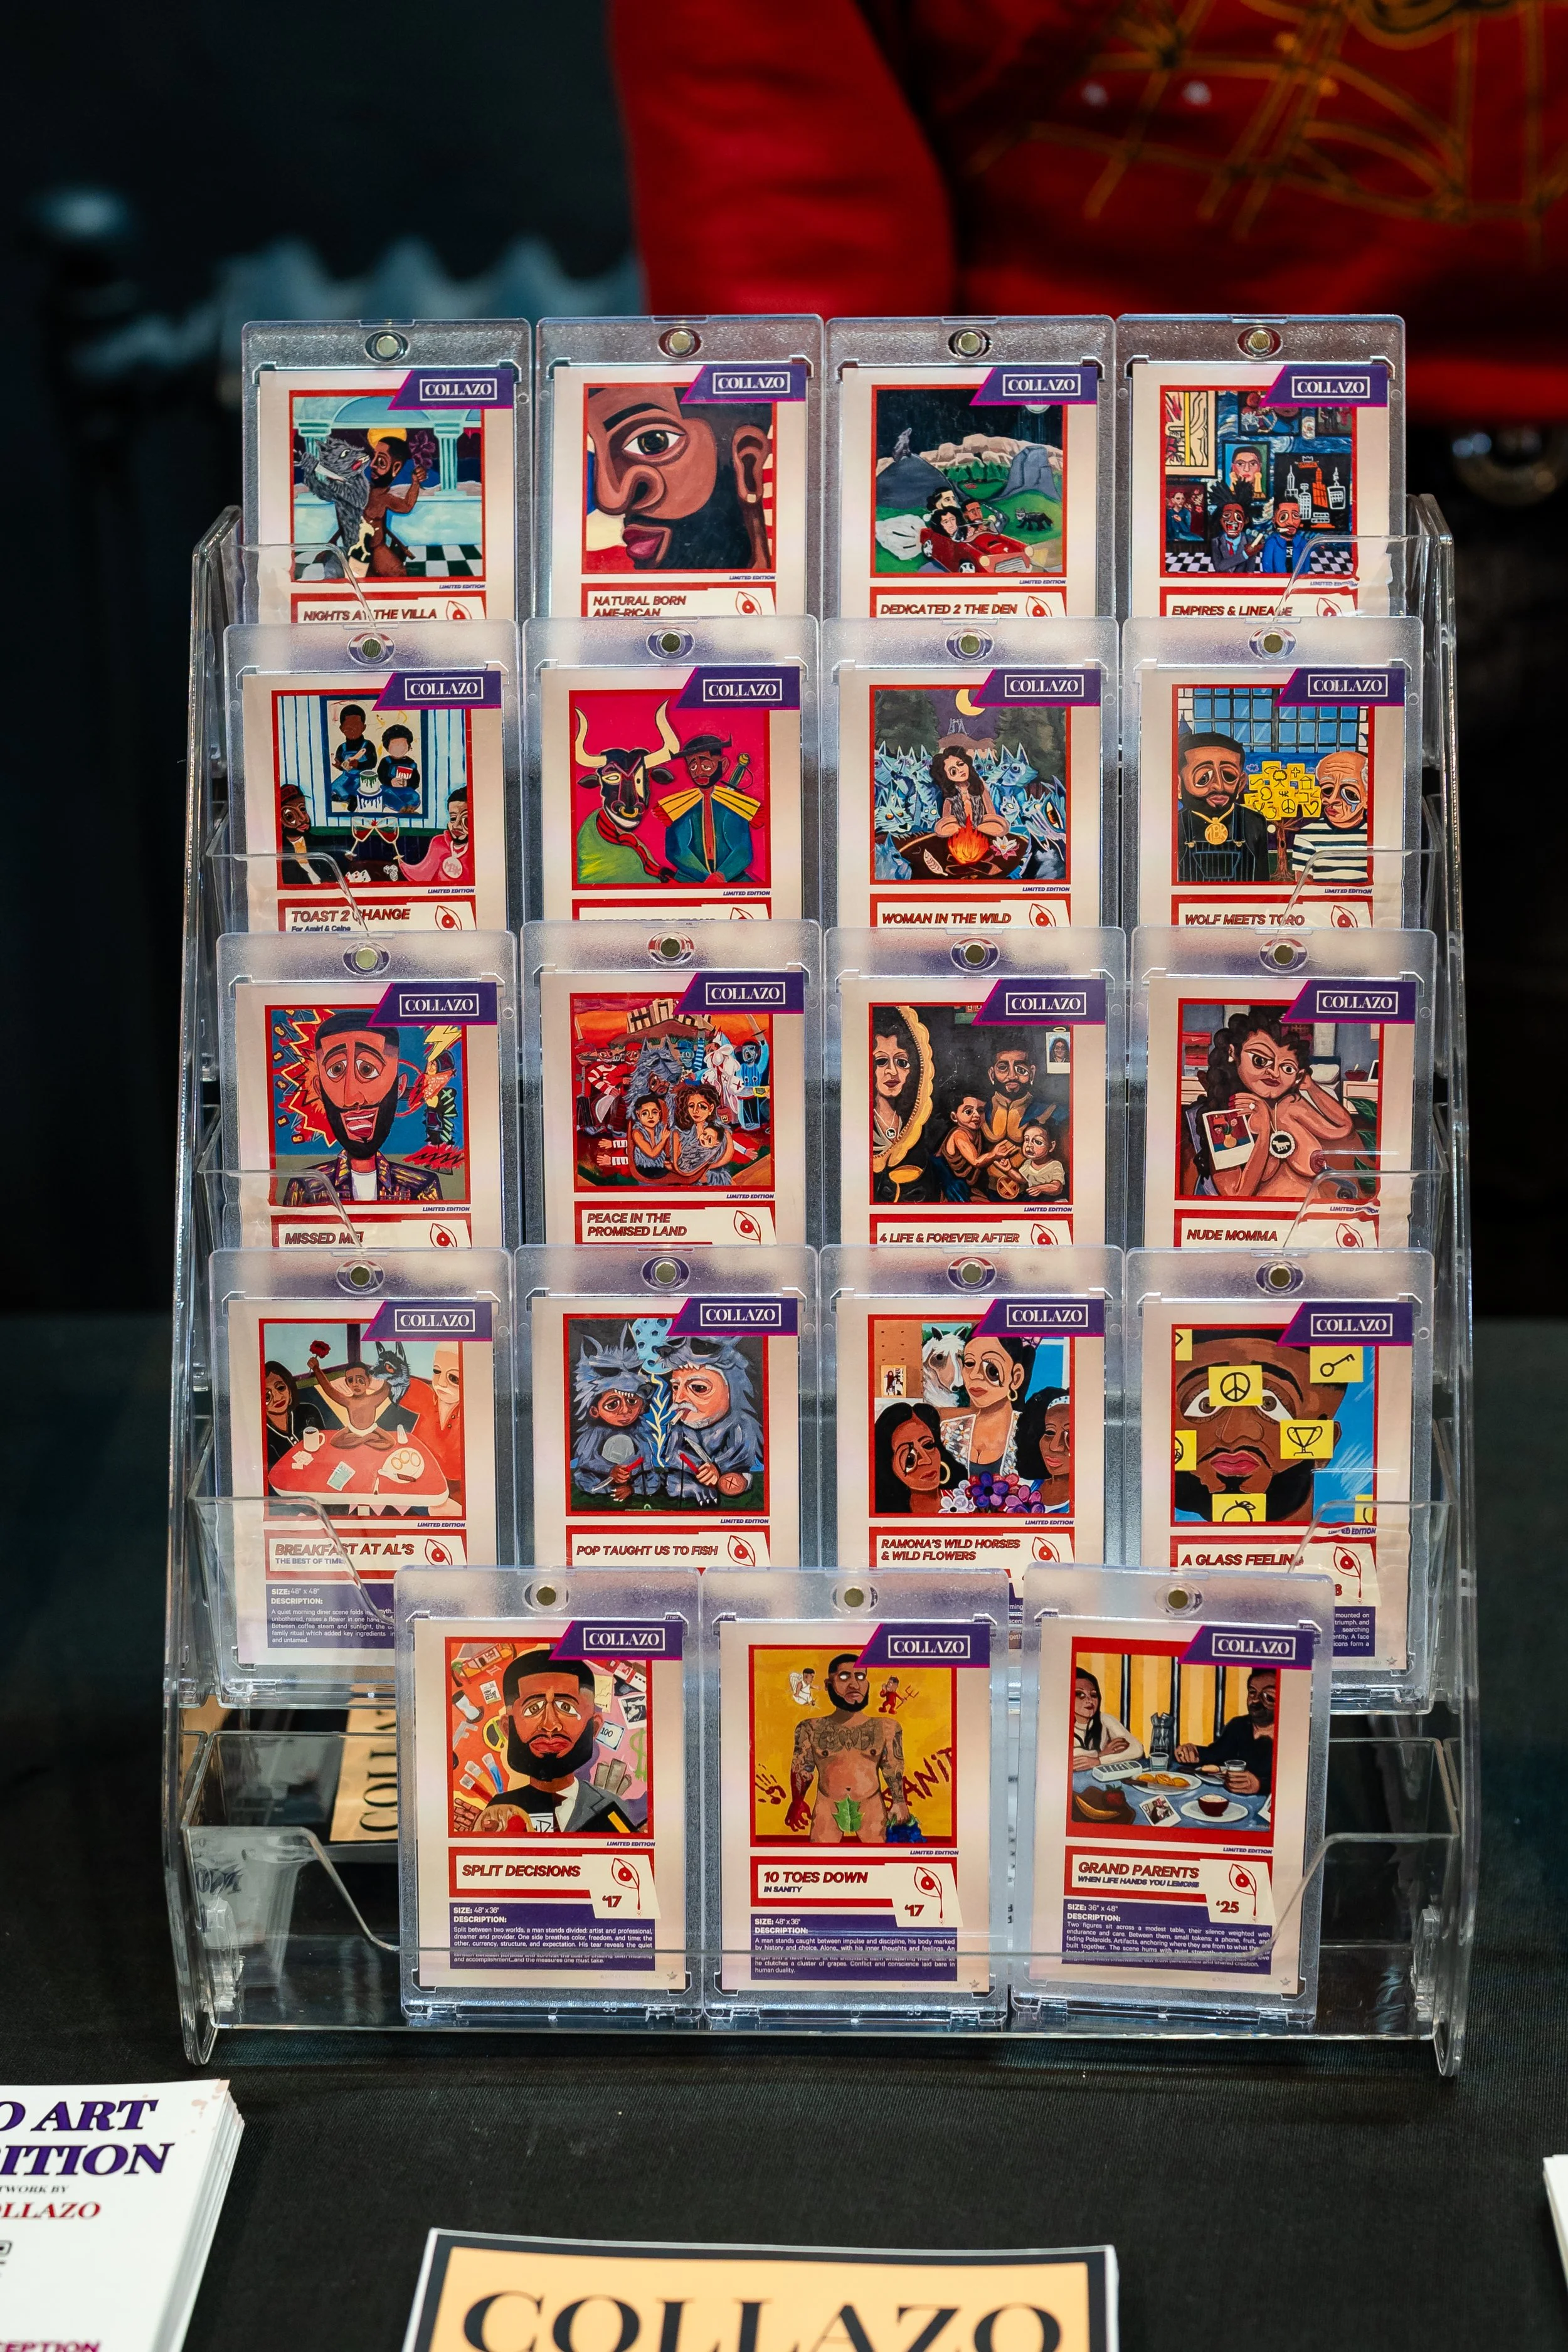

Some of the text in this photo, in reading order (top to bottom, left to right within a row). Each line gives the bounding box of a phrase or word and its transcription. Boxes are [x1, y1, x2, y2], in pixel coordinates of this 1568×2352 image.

[718, 376, 785, 389] COLLAZO
[1008, 379, 1076, 391] COLLAZO
[1297, 381, 1365, 393] COLLAZO
[425, 383, 492, 396] COLLAZO
[593, 595, 687, 606] NATURAL BORN
[304, 609, 350, 621] NIGHTS
[373, 608, 398, 620] THE
[401, 608, 437, 619] VILLA
[880, 603, 1018, 615] DEDICATED 2 THE DEN
[1172, 605, 1225, 616] EMPIRES
[1227, 605, 1237, 616] &
[410, 682, 478, 695] COLLAZO
[708, 684, 777, 696] COLLAZO
[1010, 679, 1079, 692] COLLAZO
[1313, 679, 1382, 692] COLLAZO
[292, 910, 339, 923] TOAST
[340, 910, 349, 922] 2
[882, 913, 1012, 924] WOMAN IN THE WILD
[1185, 914, 1222, 925] WOLF
[1223, 914, 1266, 925] MEETS
[711, 987, 780, 1000] COLLAZO
[405, 999, 474, 1012] COLLAZO
[1011, 997, 1081, 1010] COLLAZO
[1322, 996, 1392, 1009] COLLAZO
[587, 1212, 672, 1223] PEACE IN THE
[587, 1226, 687, 1237] PROMISED LAND
[1187, 1229, 1278, 1241] NUDE MOMMA
[285, 1232, 336, 1244] MISSED
[879, 1233, 1020, 1243] 4 LIFE & FOREVER AFTER
[400, 1314, 470, 1327] COLLAZO
[706, 1308, 776, 1321] COLLAZO
[1012, 1310, 1083, 1322] COLLAZO
[1316, 1319, 1387, 1332] COLLAZO
[275, 1543, 415, 1556] BREAKFAST AT AL'S
[576, 1545, 719, 1555] POP TAUGHT US TO FISH
[881, 1539, 1021, 1549] RAMONA'S WILD HORSES
[881, 1551, 977, 1560] & WILD FLOWERS
[1181, 1554, 1304, 1566] A GLASS FEELIN
[589, 1633, 660, 1646] COLLAZO
[894, 1641, 965, 1653] COLLAZO
[1218, 1639, 1290, 1655] COLLAZO
[600, 1727, 613, 1737] 100
[462, 1865, 581, 1877] SPLIT DECISIONS
[1078, 1861, 1200, 1878] GRAND PARENTS
[764, 1872, 868, 1883] 10 TOES DOWN
[1078, 1875, 1101, 1883] WHEN
[1120, 1878, 1148, 1886] HANDS
[1067, 1913, 1121, 1922] DESCRIPTION:
[30, 2099, 159, 2132] ART
[0, 2143, 176, 2176] ITION
[51, 2185, 69, 2193] BY
[0, 2201, 102, 2220] LLAZO
[462, 2289, 1062, 2352] COLLAZO
